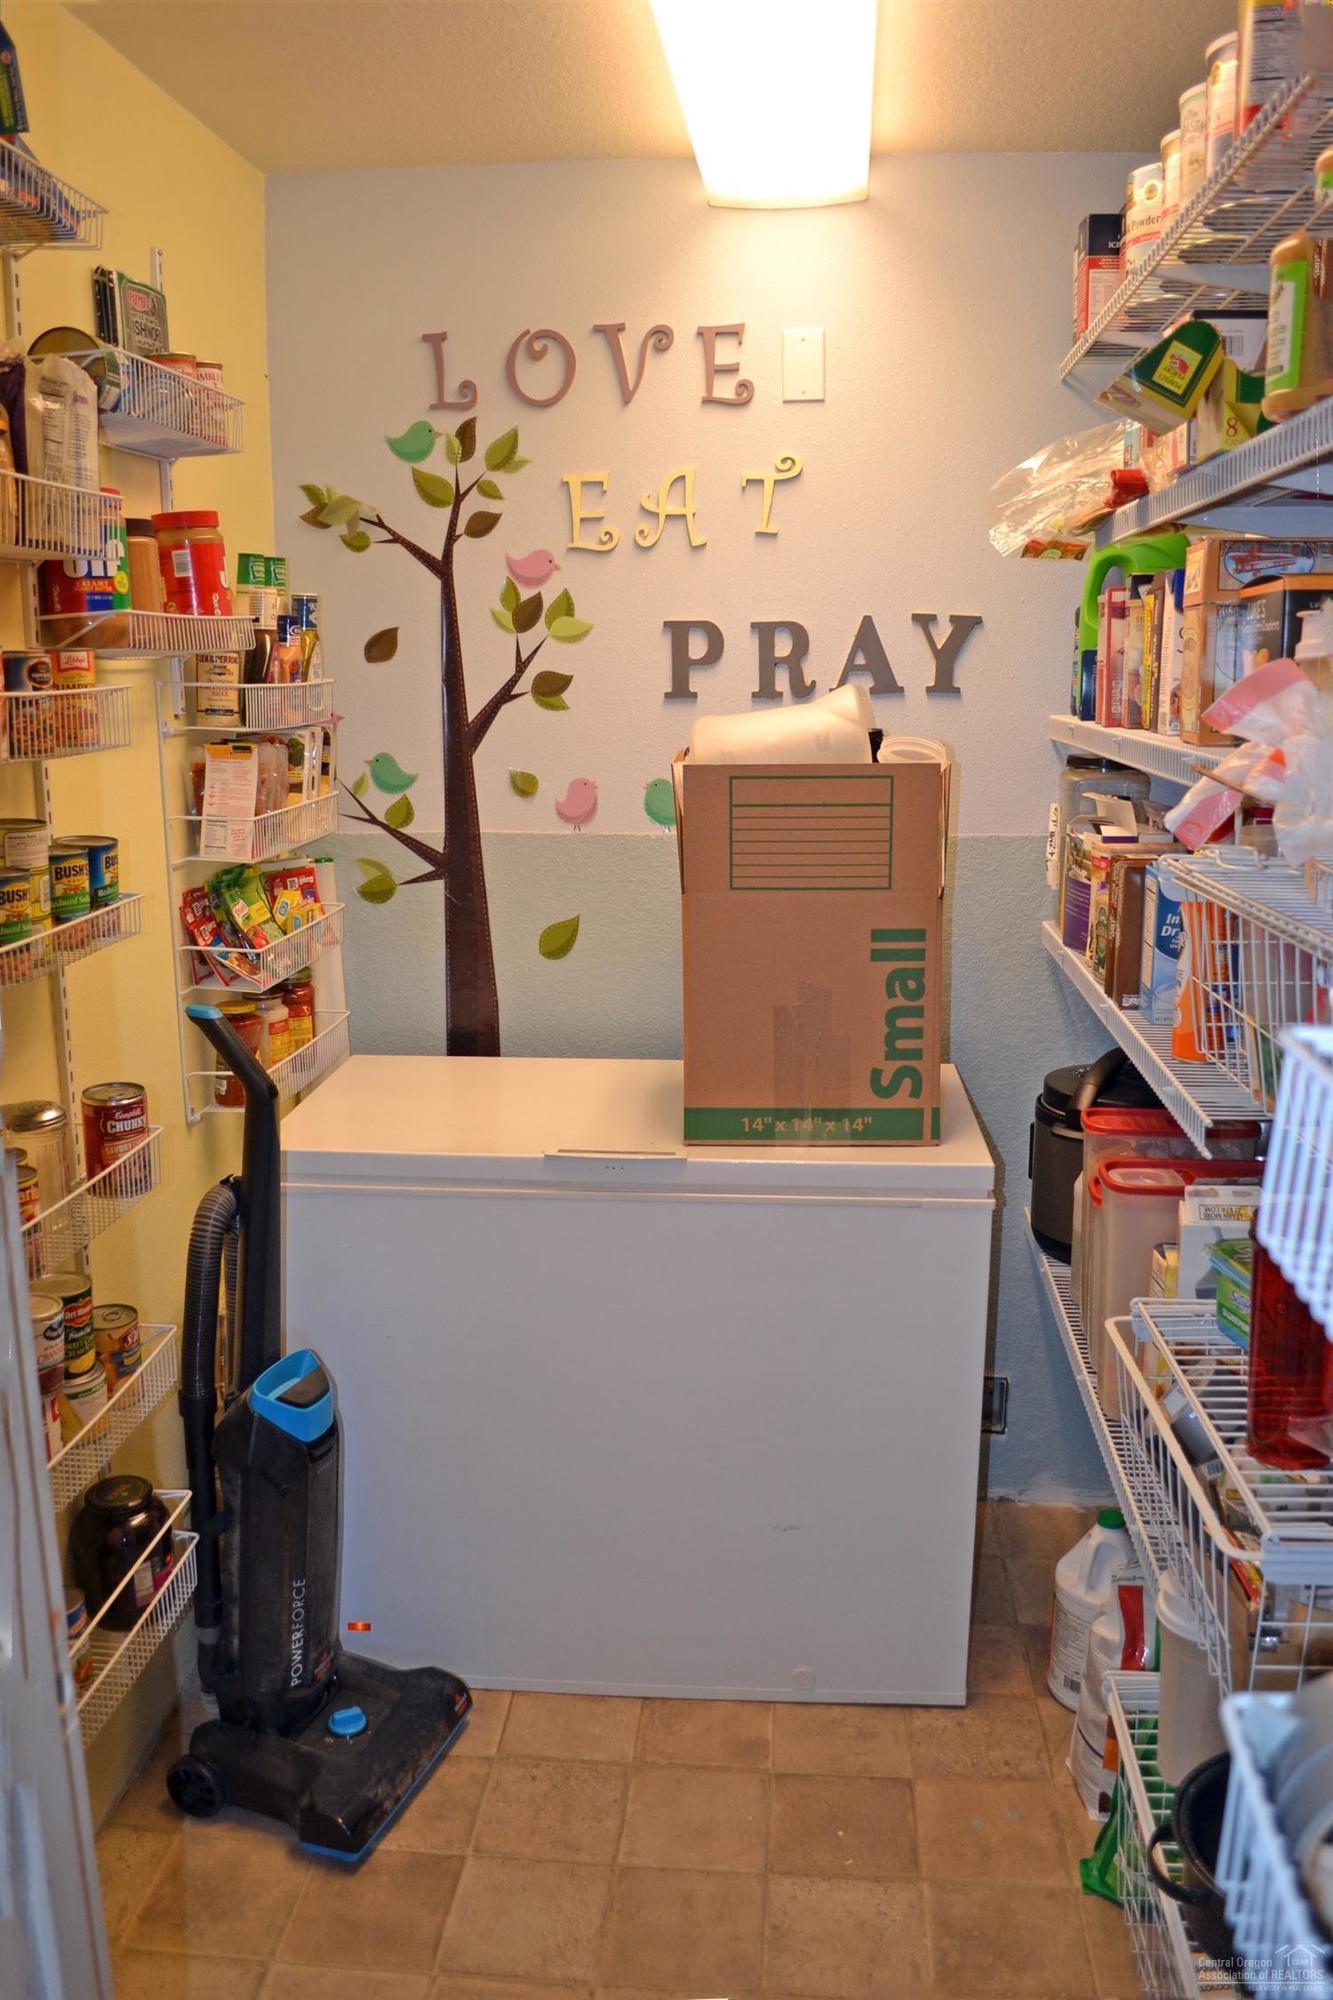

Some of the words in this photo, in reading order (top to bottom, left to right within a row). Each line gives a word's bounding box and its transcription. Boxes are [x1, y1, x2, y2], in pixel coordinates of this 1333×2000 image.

[1131, 215, 1162, 231] Powder
[422, 322, 755, 410] LOVE
[562, 451, 803, 551] EAT
[663, 612, 983, 699] PRAY
[870, 928, 926, 1099] Small
[106, 1114, 147, 1134] CHUNKY
[741, 1117, 772, 1132] 14"
[842, 1117, 873, 1132] 14"
[290, 1578, 306, 1688] POWERFORCE
